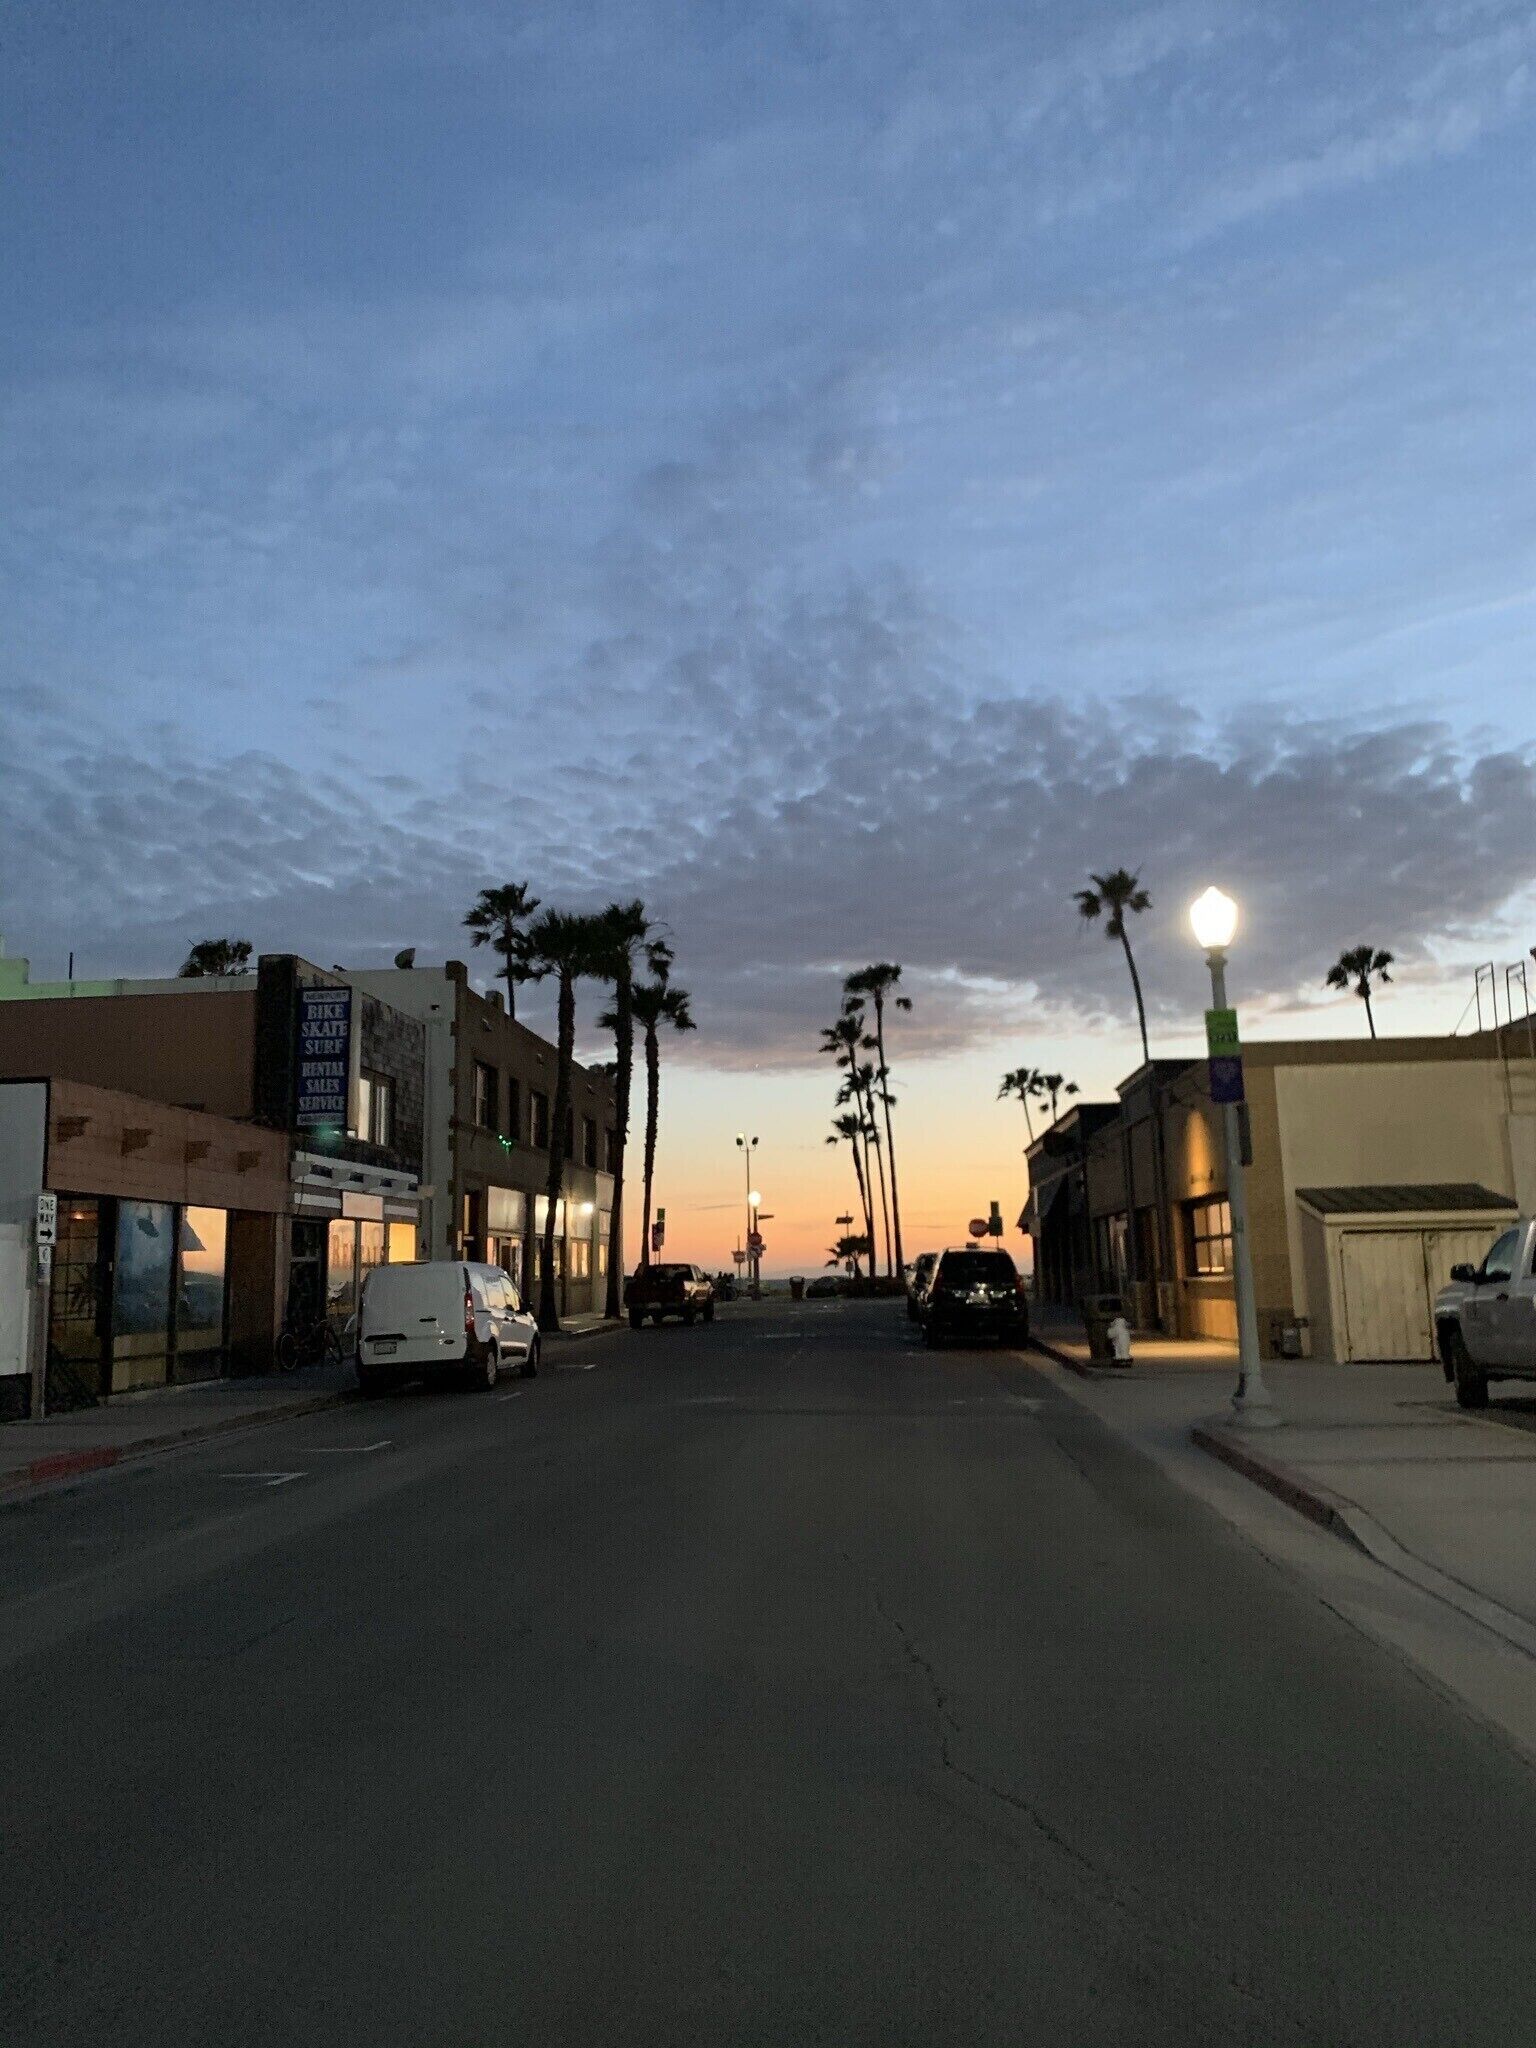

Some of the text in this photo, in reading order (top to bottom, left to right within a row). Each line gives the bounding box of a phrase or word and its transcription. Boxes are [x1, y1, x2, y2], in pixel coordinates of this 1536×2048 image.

[307, 1004, 345, 1019] BIKE
[302, 1020, 347, 1037] SKATE
[305, 1039, 344, 1055] SURF
[302, 1061, 345, 1077] RENTAL
[306, 1079, 340, 1093] SALES
[299, 1096, 345, 1111] SERVICE
[39, 1198, 54, 1211] ONE
[39, 1213, 54, 1223] WAY
